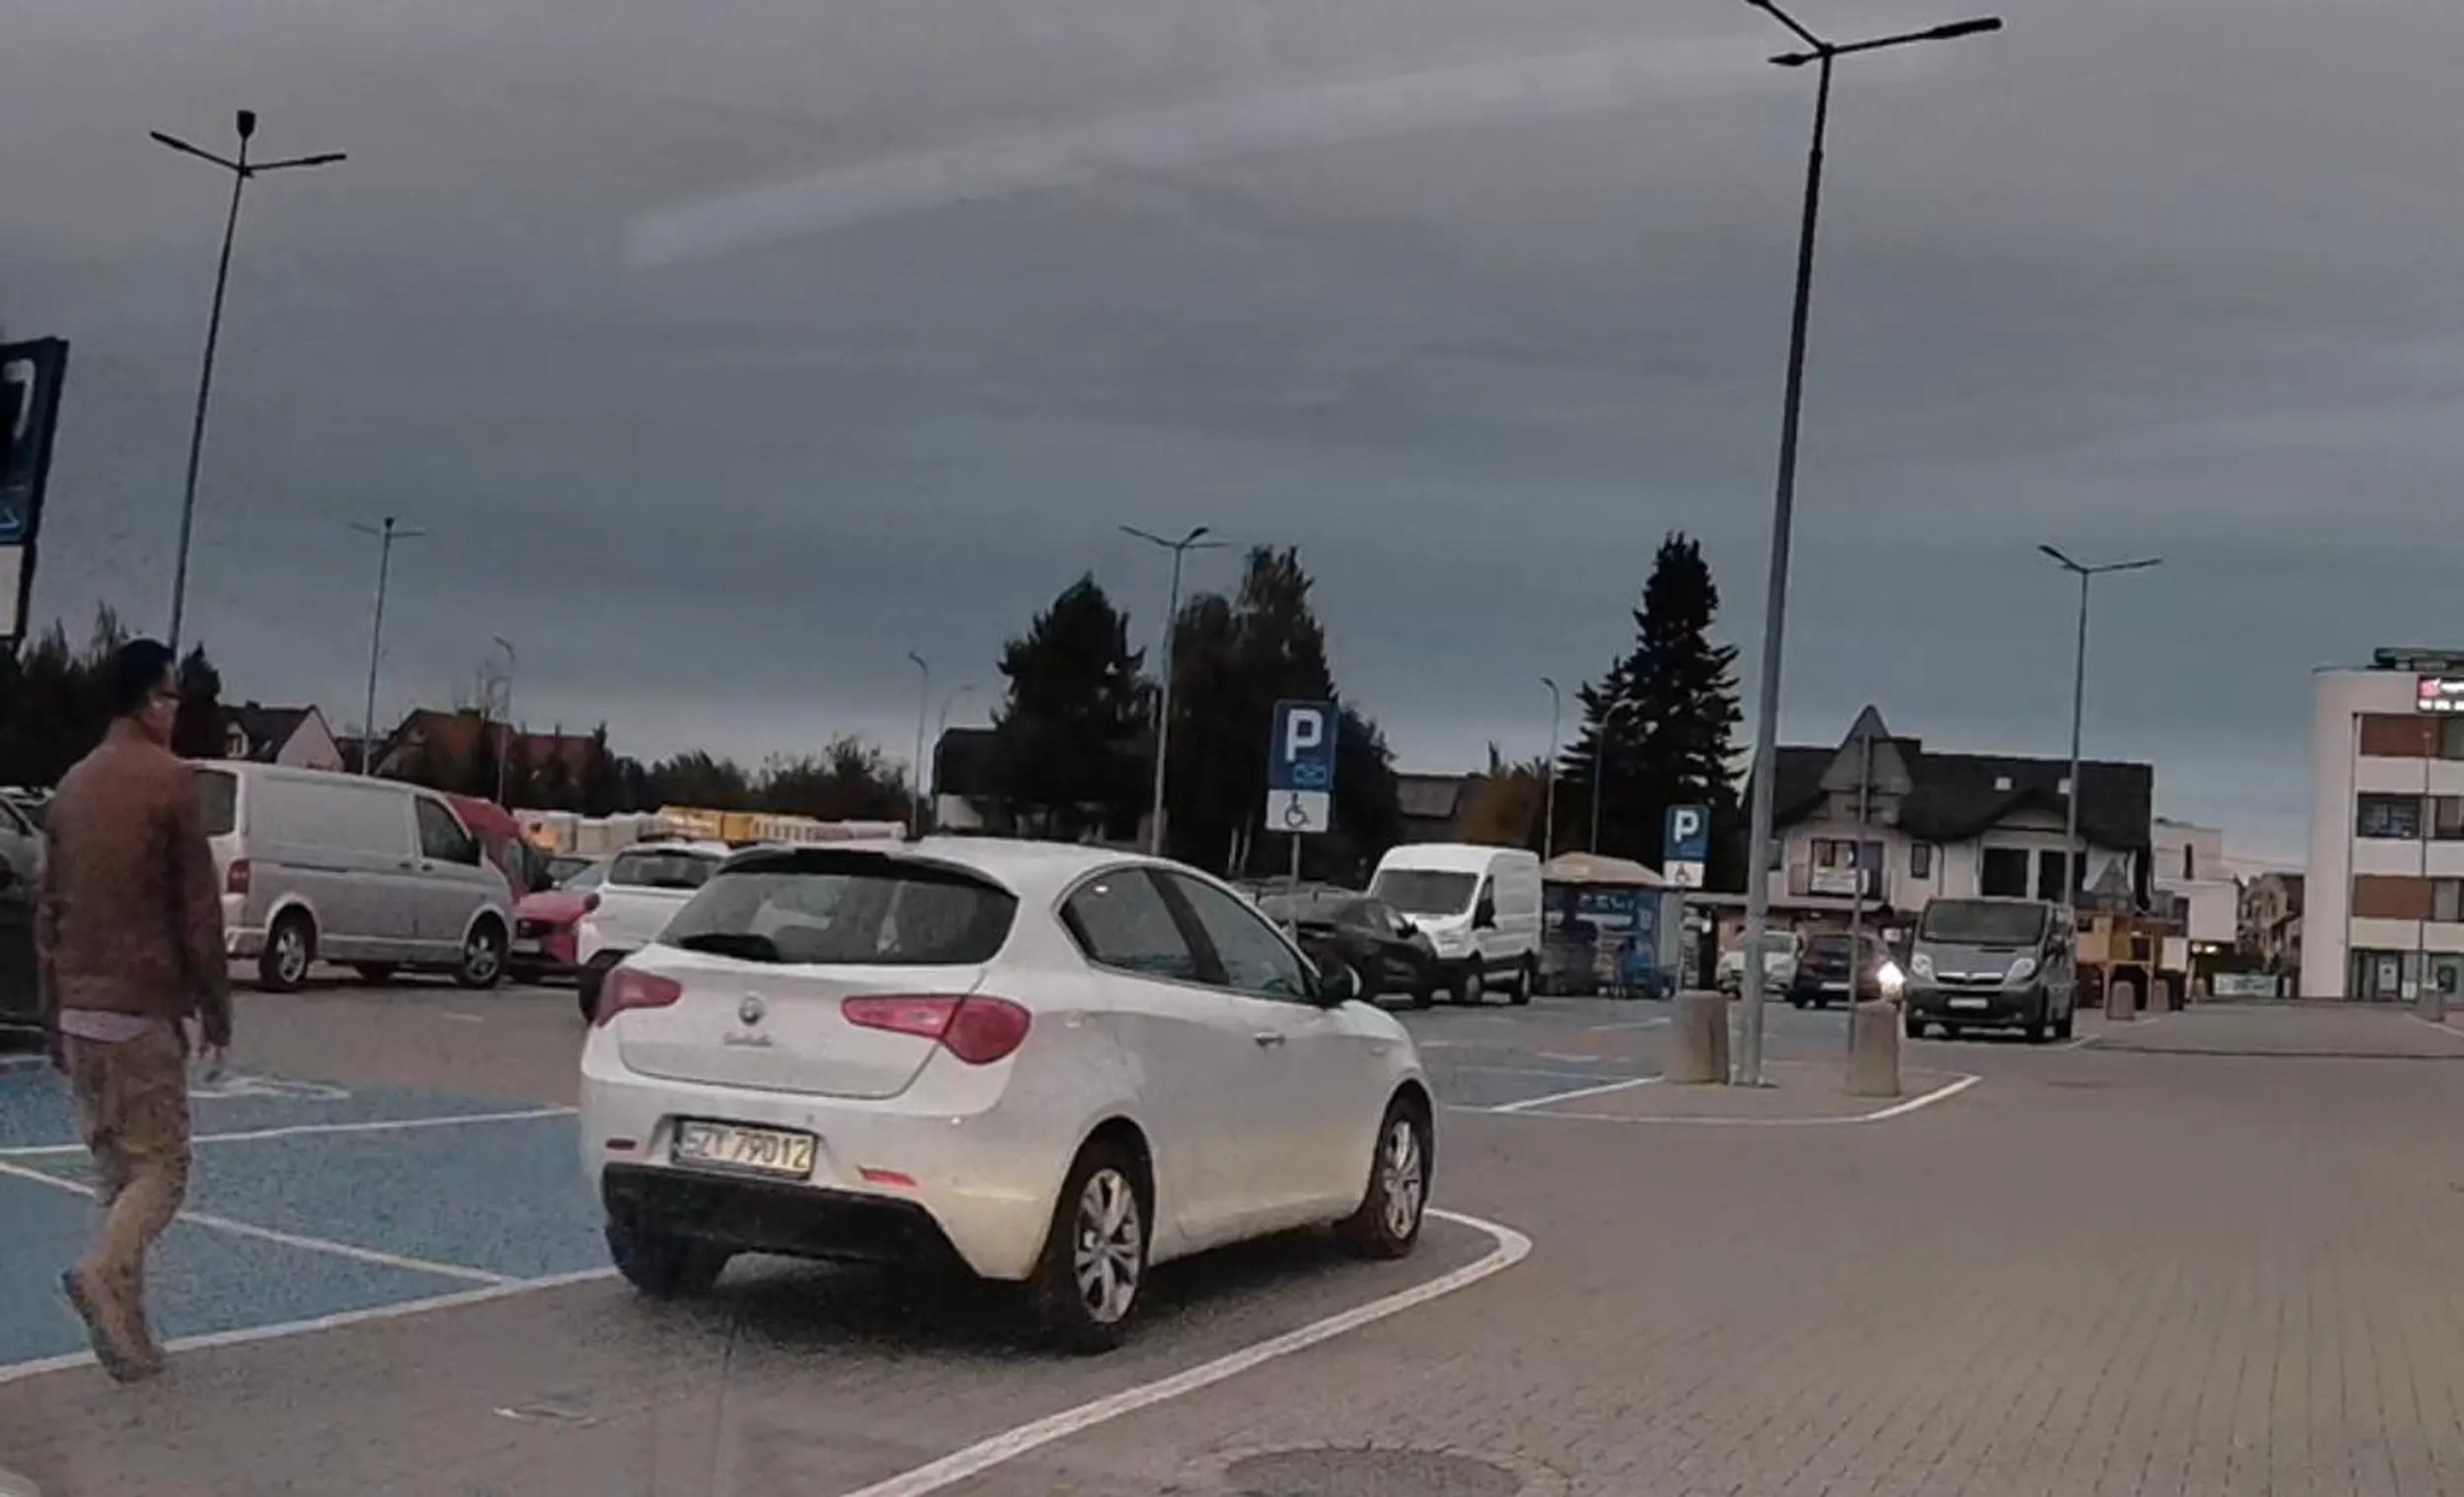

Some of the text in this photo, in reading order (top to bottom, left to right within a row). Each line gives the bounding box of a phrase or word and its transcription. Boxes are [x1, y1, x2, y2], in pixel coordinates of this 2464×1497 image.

[1285, 709, 1323, 762] P
[1675, 809, 1699, 843] P
[732, 1130, 809, 1169] 79012
